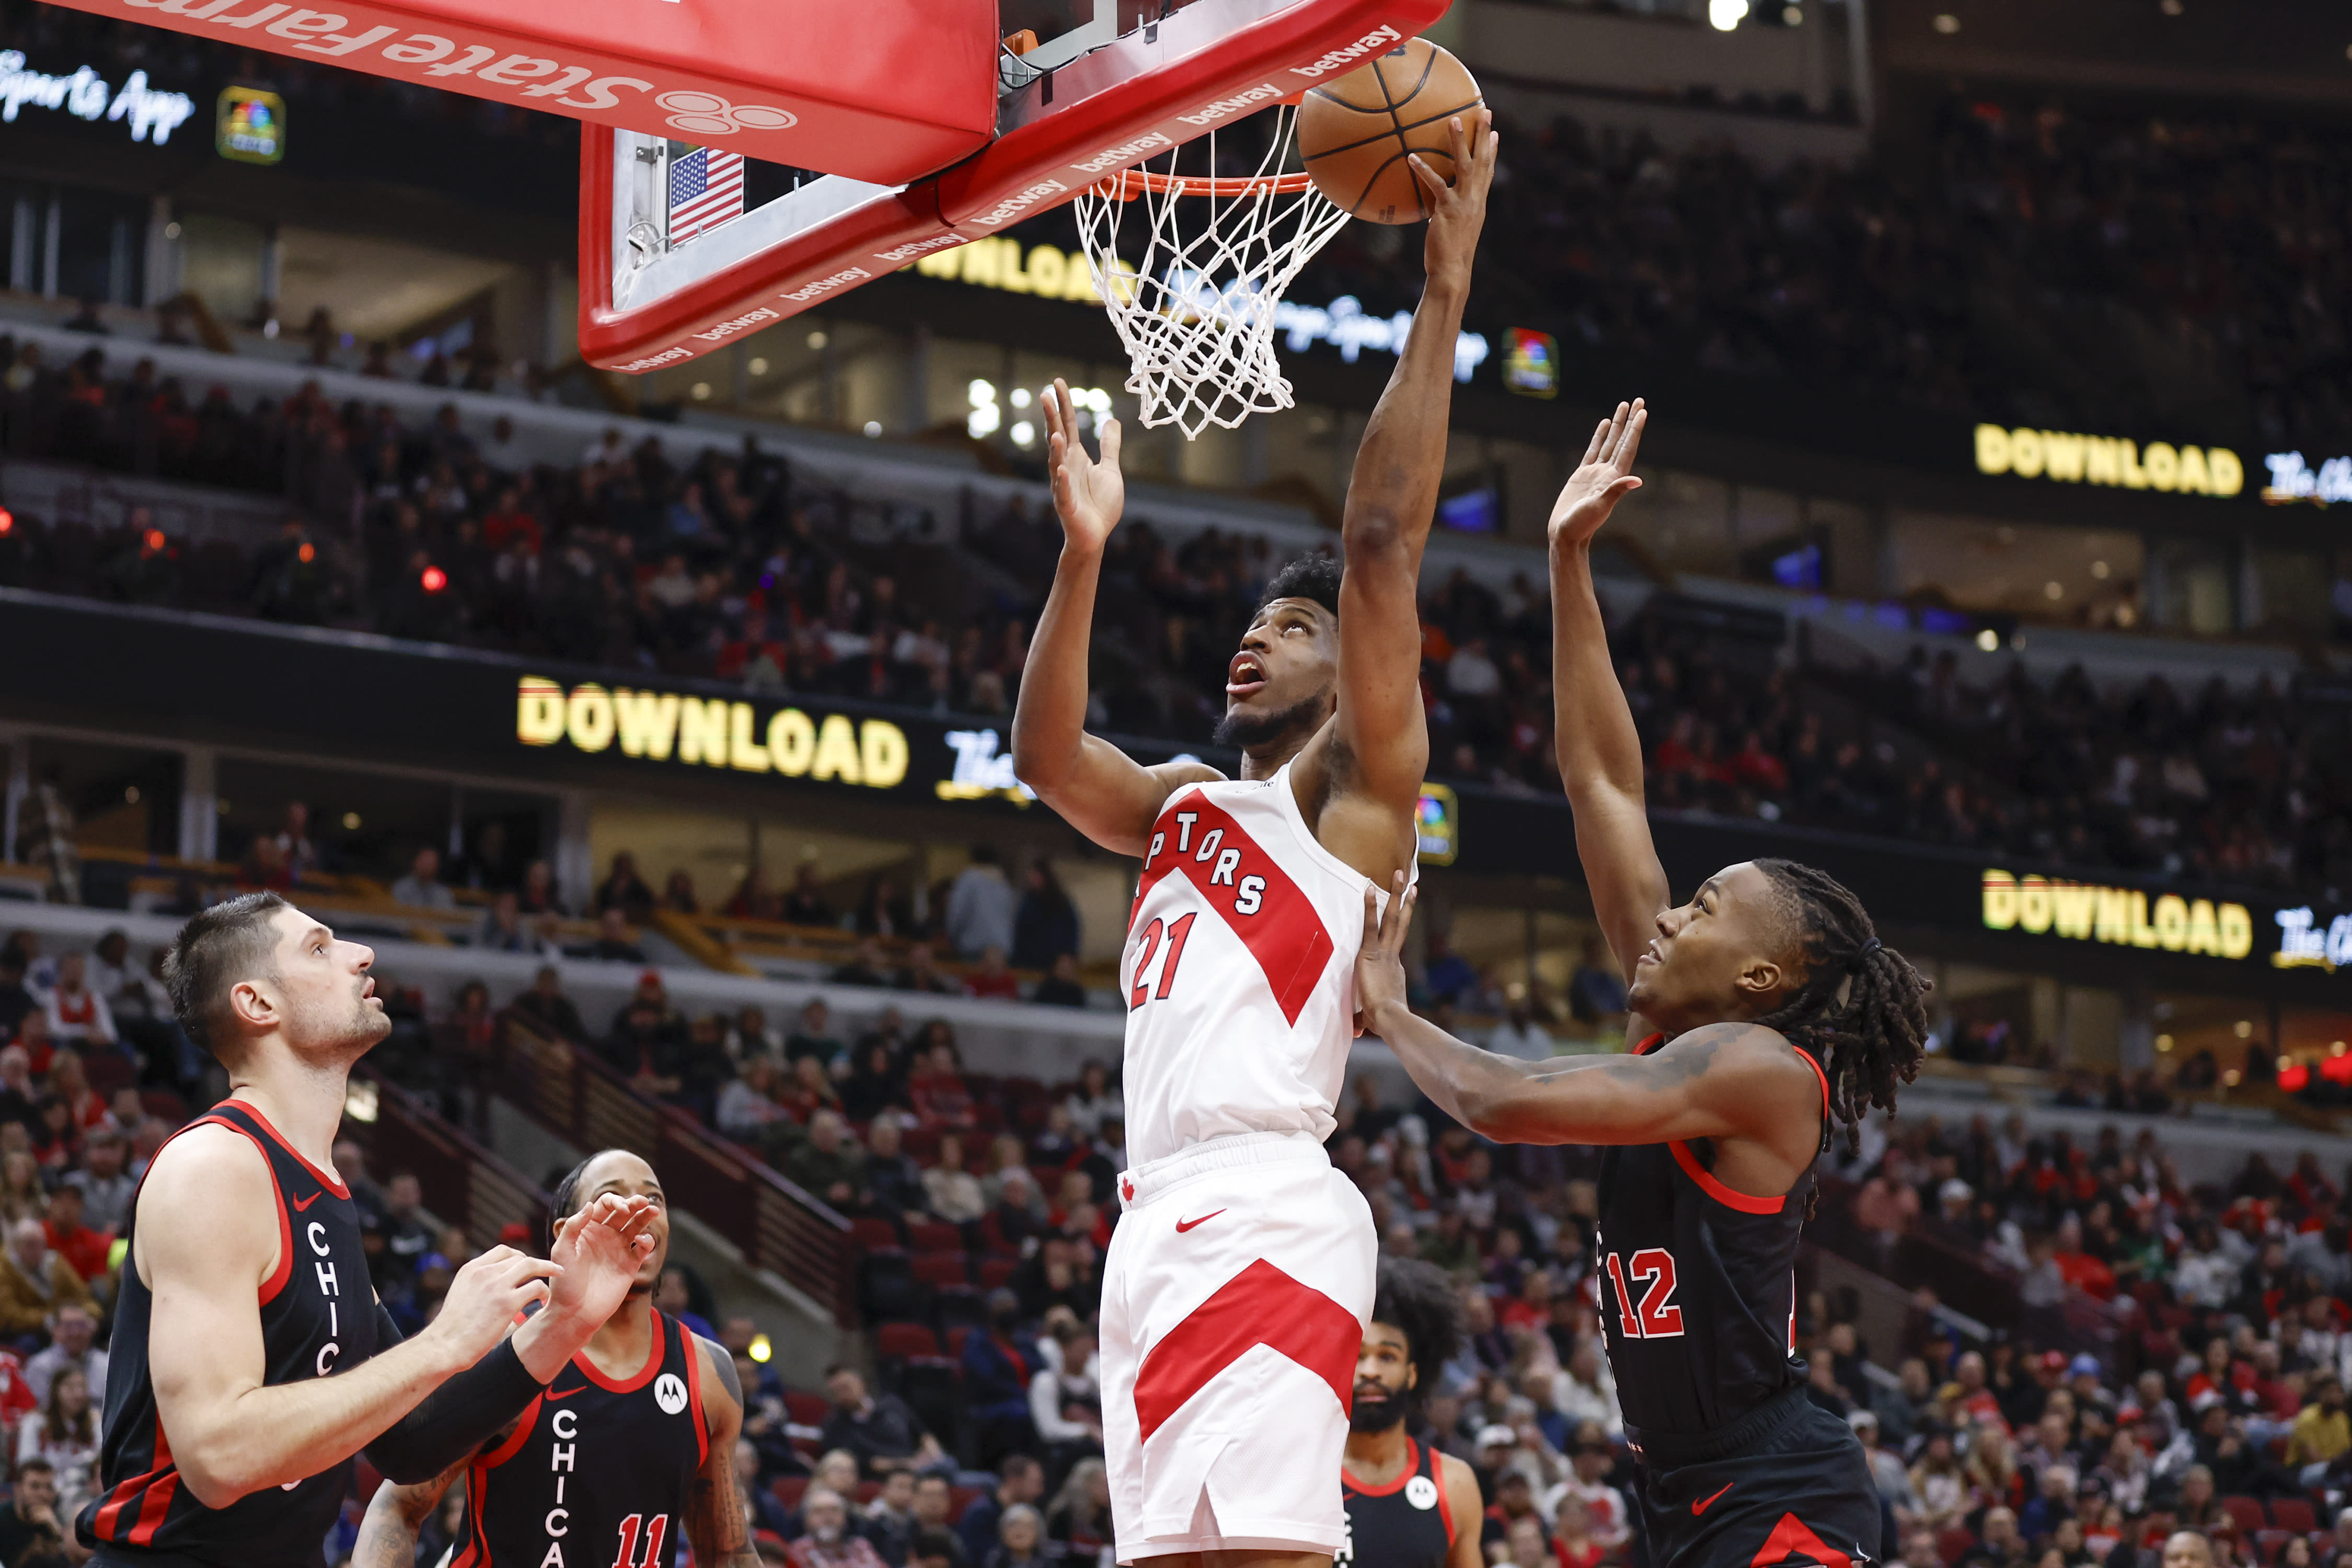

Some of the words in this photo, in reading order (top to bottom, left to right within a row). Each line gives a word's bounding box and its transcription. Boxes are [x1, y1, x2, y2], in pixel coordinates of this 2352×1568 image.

[1290, 24, 1402, 77] betway
[107, 68, 196, 146] App
[1177, 83, 1283, 125] betway
[1070, 131, 1173, 173] betway
[971, 178, 1068, 226] betway
[873, 233, 969, 262] betway
[897, 235, 1137, 307] WNLOAD
[779, 267, 872, 302] betway
[692, 307, 780, 341] betway
[611, 347, 694, 372] betway
[1974, 423, 2244, 498] DOWNLOAD
[518, 676, 909, 788] DOWNLOAD
[1981, 868, 2253, 960] DOWNLOAD
[1129, 912, 1198, 1013] 21
[1606, 1247, 1685, 1339] 12
[612, 1513, 669, 1568] 11
